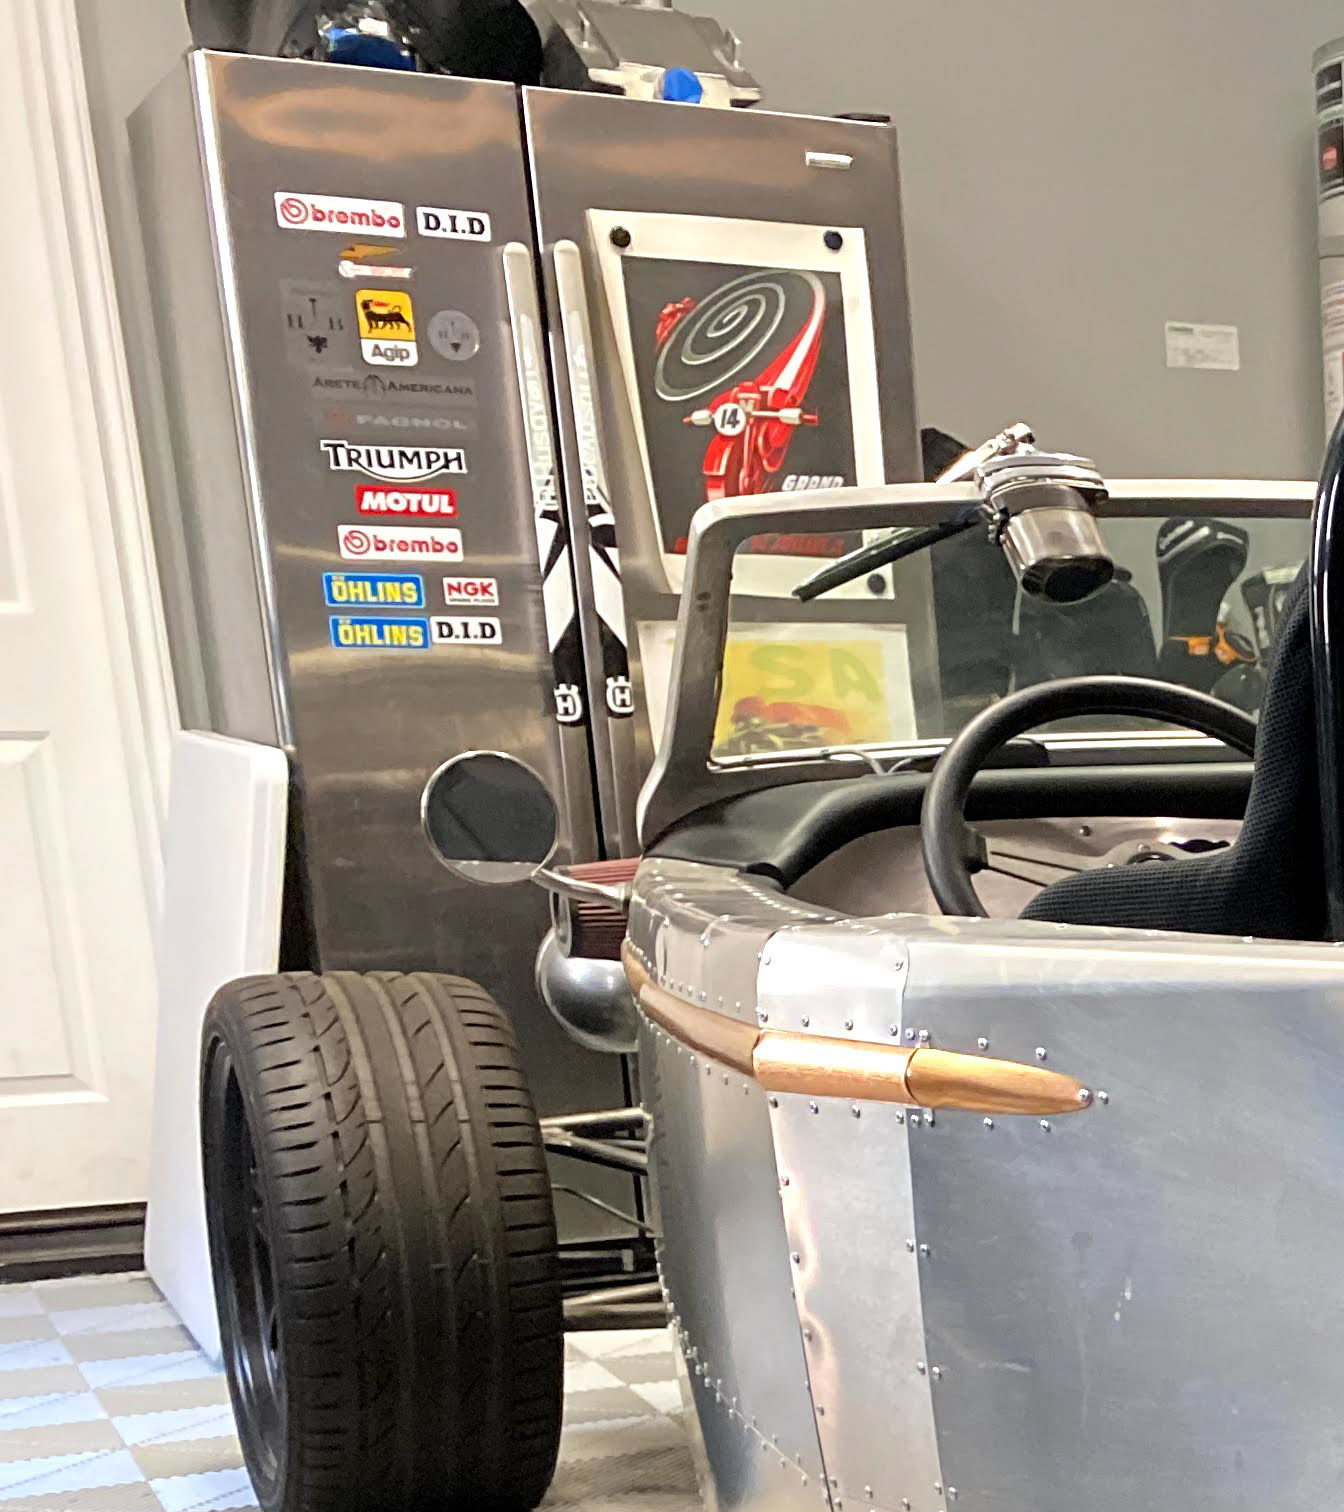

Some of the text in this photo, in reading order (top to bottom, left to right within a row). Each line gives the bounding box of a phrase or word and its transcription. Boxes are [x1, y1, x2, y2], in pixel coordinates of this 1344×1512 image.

[311, 203, 401, 229] brembo
[423, 211, 486, 236] D.I.D
[371, 343, 411, 361] Agip
[720, 407, 741, 429] 14
[323, 442, 465, 475] TRIUMPH
[781, 474, 845, 492] GRAND
[360, 490, 454, 514] MOTUL
[372, 534, 459, 554] brembo
[331, 575, 419, 603] ÖHLINS
[447, 581, 495, 597] NGK
[338, 618, 424, 647] ÖHLINS
[436, 621, 497, 639] D.I.D
[750, 644, 883, 702] SA
